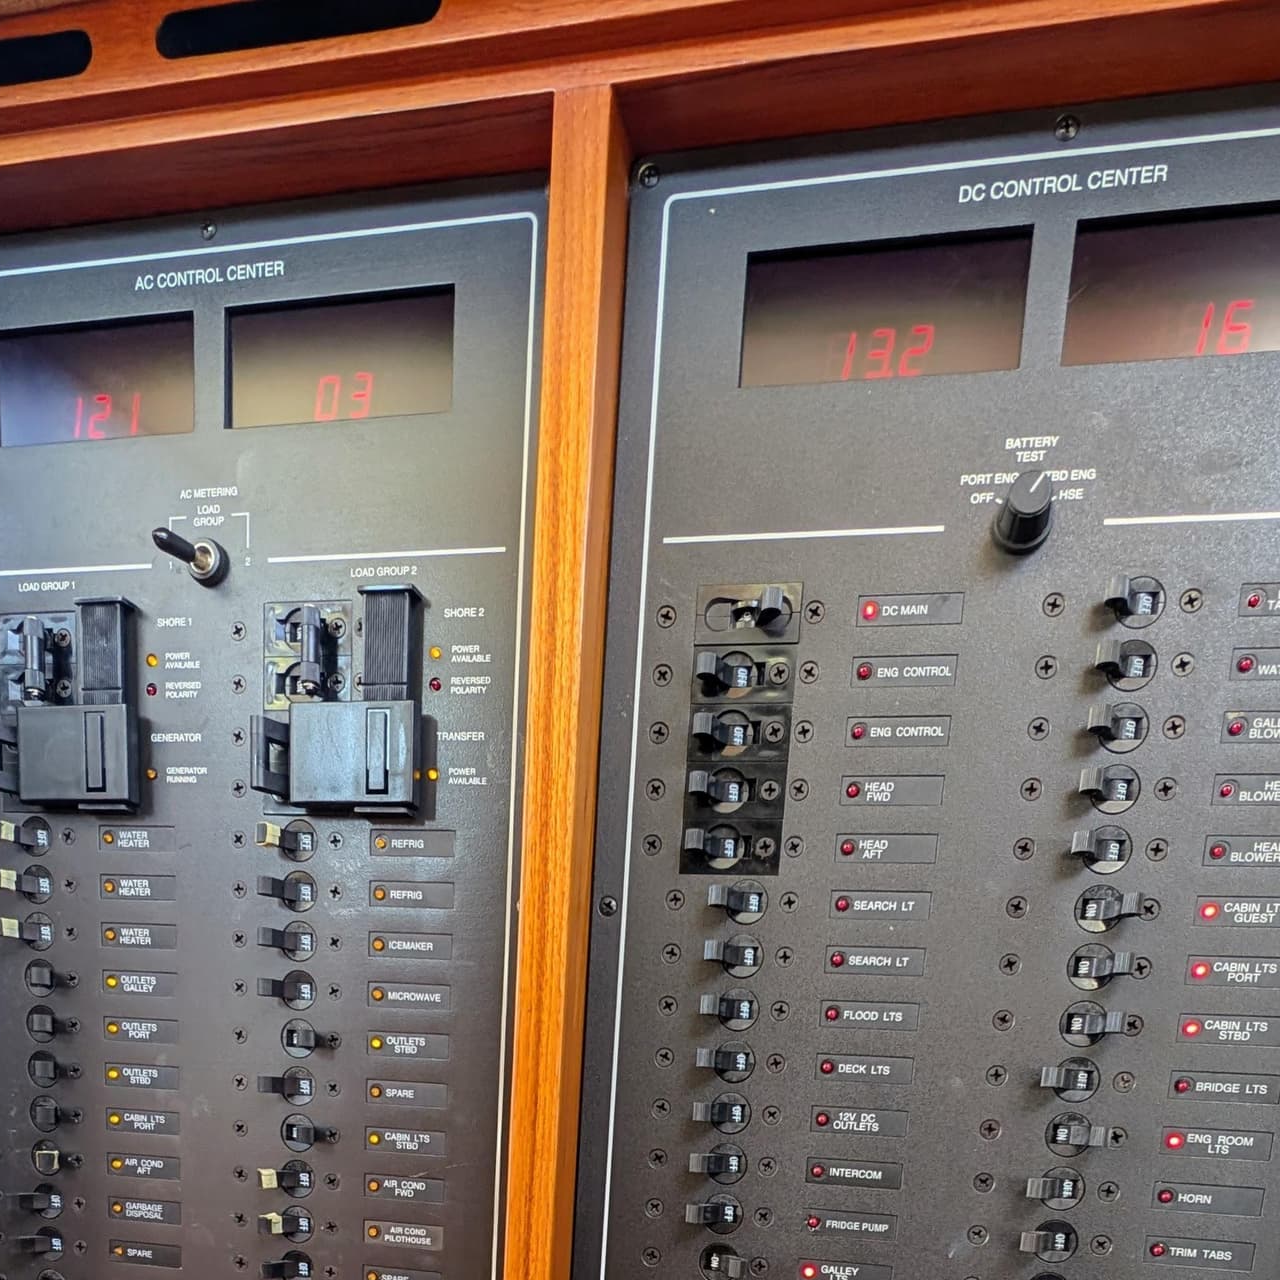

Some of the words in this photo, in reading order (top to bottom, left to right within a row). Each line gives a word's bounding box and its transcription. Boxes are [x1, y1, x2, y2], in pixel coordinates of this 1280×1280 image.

[958, 185, 988, 203] DC
[990, 175, 1082, 199] CONTROL
[1087, 165, 1168, 188] CENTER
[135, 274, 154, 291] AC
[156, 267, 224, 289] CONTROL
[226, 261, 285, 282] CENTER
[1198, 301, 1253, 355] 16
[315, 373, 374, 421] 03
[73, 394, 140, 439] 121
[1005, 437, 1059, 450] BATTERY
[1016, 452, 1045, 463] TEST
[960, 474, 991, 486] PORT
[1070, 469, 1096, 481] ENG
[180, 490, 192, 499] AC
[194, 487, 238, 498] METERING
[1059, 489, 1083, 500] HSE
[970, 493, 994, 504] OFF
[197, 505, 220, 515] LOAD
[193, 517, 224, 527] GROUP
[351, 568, 374, 578] LOAD
[377, 567, 407, 577] GROUP
[410, 567, 417, 575] 2
[19, 583, 39, 592] LOAD
[40, 582, 68, 592] GROUP
[71, 581, 75, 589] 1
[444, 609, 476, 618] SHORE
[478, 608, 485, 617] 2
[882, 606, 898, 616] DC
[901, 605, 928, 615] MAIN
[157, 619, 186, 627] SHORE
[188, 618, 192, 626] 1
[452, 645, 480, 654] POWER
[452, 654, 491, 663] AVAILABLE
[878, 668, 898, 678] ENG
[903, 667, 951, 677] CONTROL
[451, 677, 491, 686] REVERSED
[451, 686, 486, 695] POLARITY
[151, 733, 201, 743] GENERATOR
[437, 732, 485, 741] TRANSFER
[865, 783, 894, 791] HEAD
[867, 793, 890, 801] FWD
[119, 831, 147, 840] WATER
[118, 840, 149, 848] HEATER
[392, 840, 424, 848] REFRIG
[854, 901, 897, 911] SEARCH
[902, 902, 914, 911] LT
[1224, 903, 1260, 913] CABIN
[1234, 913, 1276, 923] GUEST
[389, 942, 433, 951] ICEMAKER
[121, 976, 156, 985] OUTLETS
[124, 984, 154, 993] GALLEY
[388, 992, 441, 1002] MICROWAVE
[843, 1011, 878, 1021] FLOOD
[883, 1012, 903, 1022] LTS
[838, 1064, 866, 1074] DECK
[871, 1065, 890, 1075] LTS
[1196, 1082, 1240, 1093] BRIDGE
[1245, 1084, 1267, 1094] LTS
[838, 1113, 856, 1121] 12V
[861, 1114, 876, 1122] DC
[833, 1121, 879, 1131] OUTLETS
[385, 1132, 410, 1142] CABIN
[414, 1134, 430, 1143] LTS
[1187, 1134, 1212, 1143] ENG
[1218, 1136, 1253, 1146] ROOM
[396, 1142, 418, 1150] STBD
[1208, 1145, 1229, 1155] LTS
[829, 1168, 882, 1179] INTERCOM
[1178, 1193, 1212, 1204] HORN
[826, 1220, 860, 1230] FRIDGE
[862, 1222, 888, 1232] PUMP
[390, 1227, 403, 1235] AIR
[404, 1228, 426, 1236] COND
[384, 1234, 432, 1245] PILOTHOUSE
[1169, 1247, 1197, 1257] TRIM
[1202, 1250, 1232, 1261] TABS
[821, 1265, 858, 1276] GALLEY
